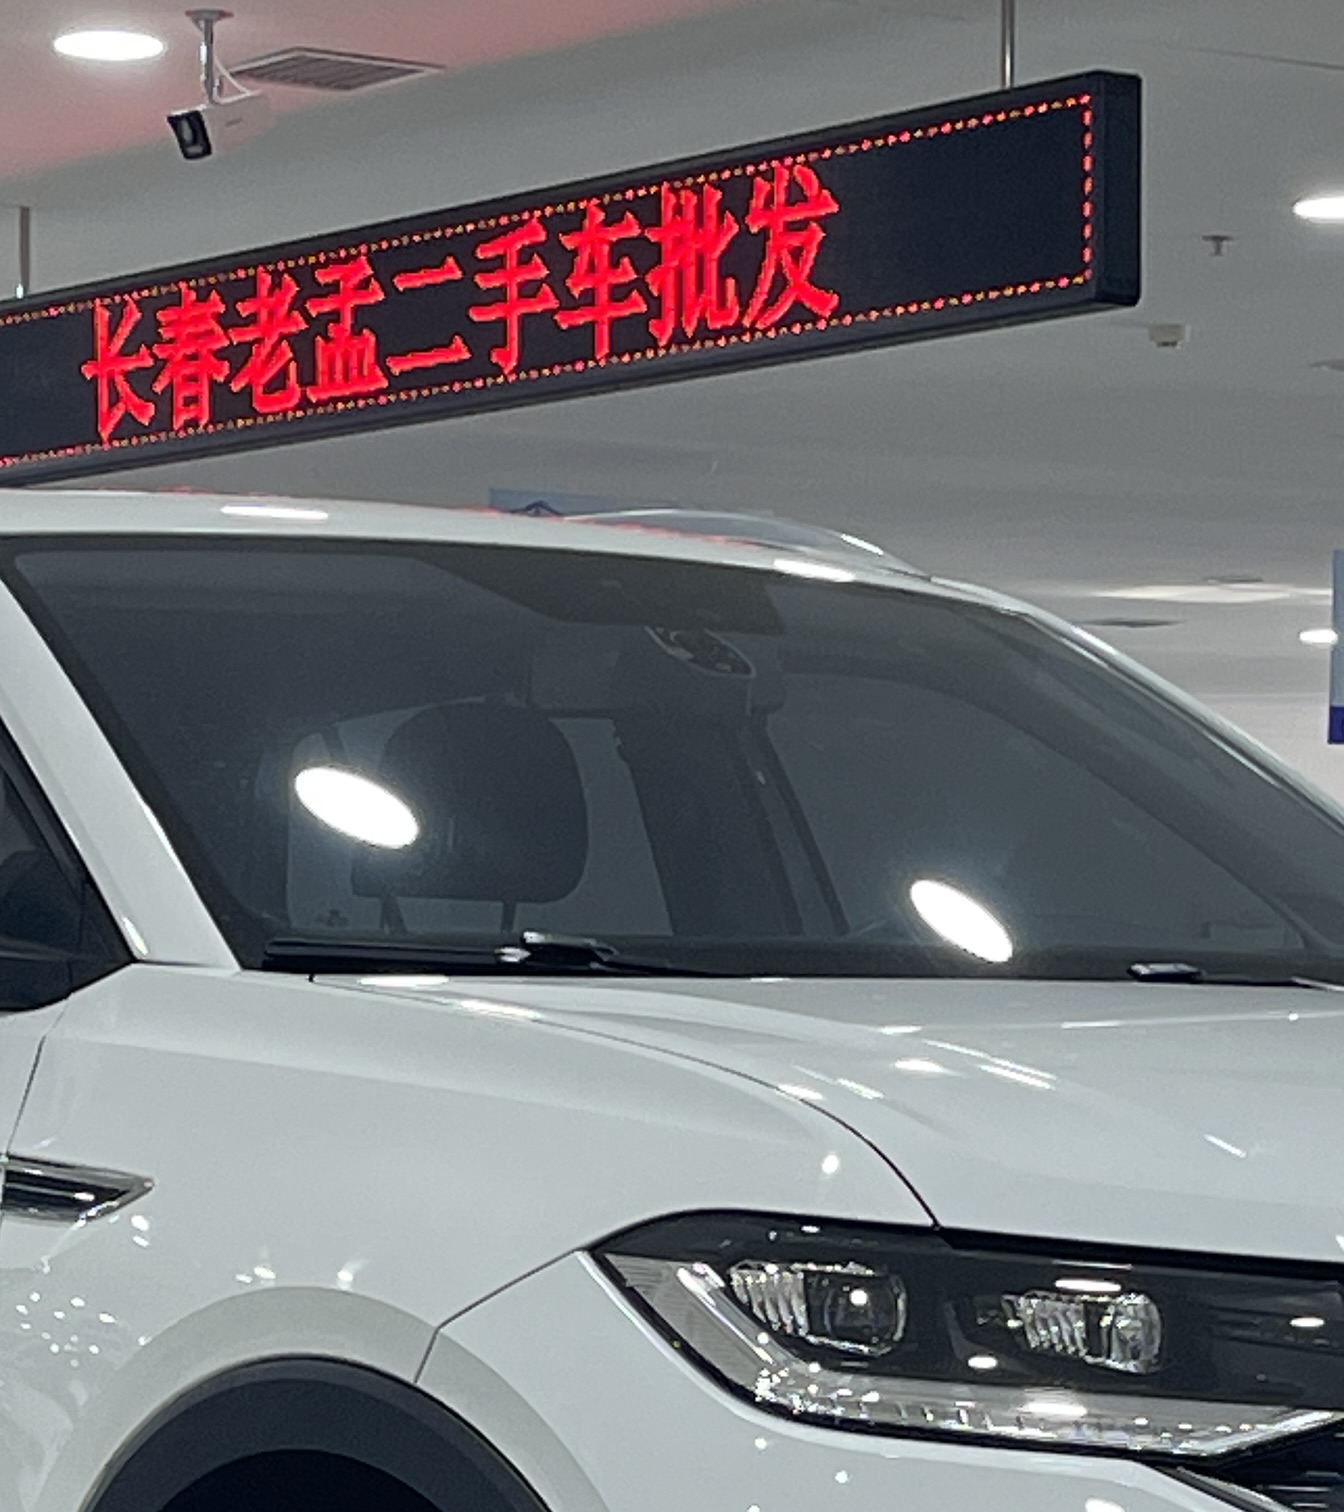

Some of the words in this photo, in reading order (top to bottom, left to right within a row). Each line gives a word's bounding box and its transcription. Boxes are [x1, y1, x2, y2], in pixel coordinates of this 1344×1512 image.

[81, 162, 839, 438] 长春老孟二手车批发
